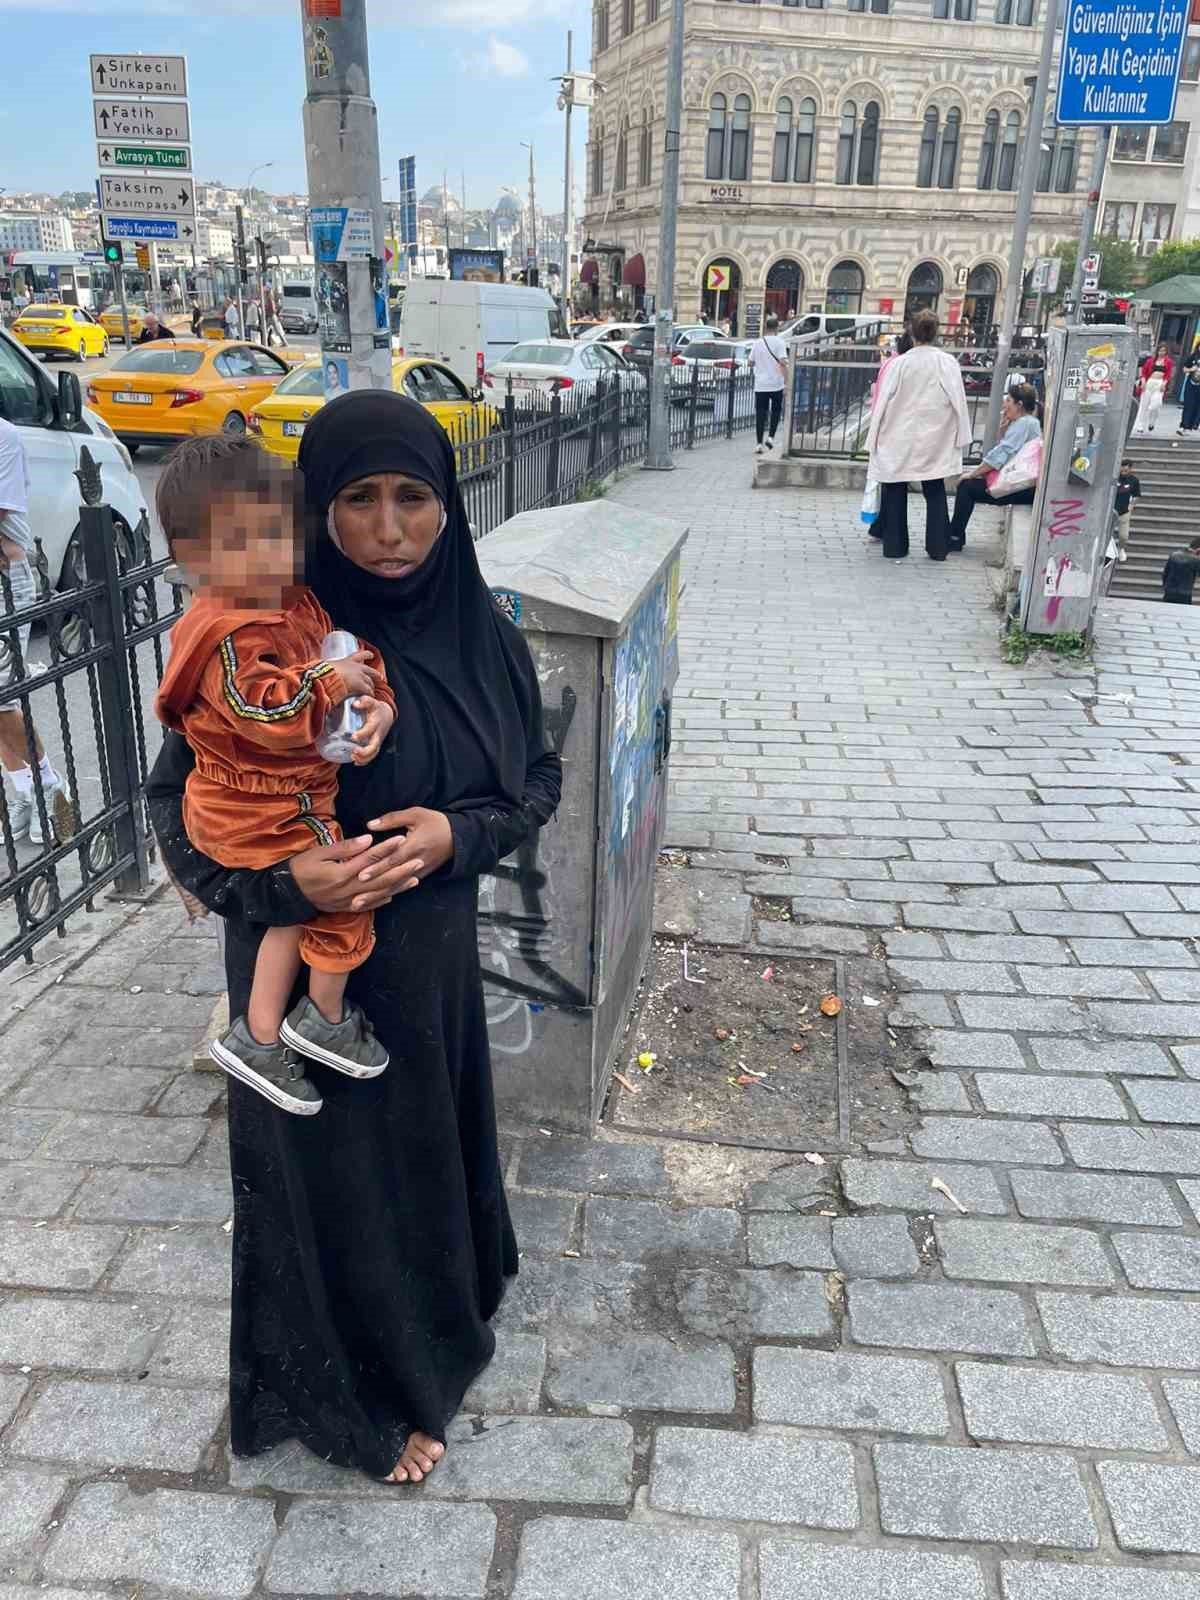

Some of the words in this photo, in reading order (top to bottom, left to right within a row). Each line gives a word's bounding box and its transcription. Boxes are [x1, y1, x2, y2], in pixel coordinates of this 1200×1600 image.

[1156, 0, 1182, 41] İçin
[108, 59, 168, 73] Sirkeci
[1068, 47, 1098, 83] Yaya
[1099, 47, 1119, 76] Alt
[1121, 47, 1177, 83] Geçidini
[109, 77, 177, 92] Unkapanı
[1083, 84, 1148, 113] Kullanınız
[112, 105, 154, 119] Fatih
[114, 121, 178, 138] Yenikapı
[116, 151, 154, 164] Avrasya
[104, 180, 164, 194] Taksim
